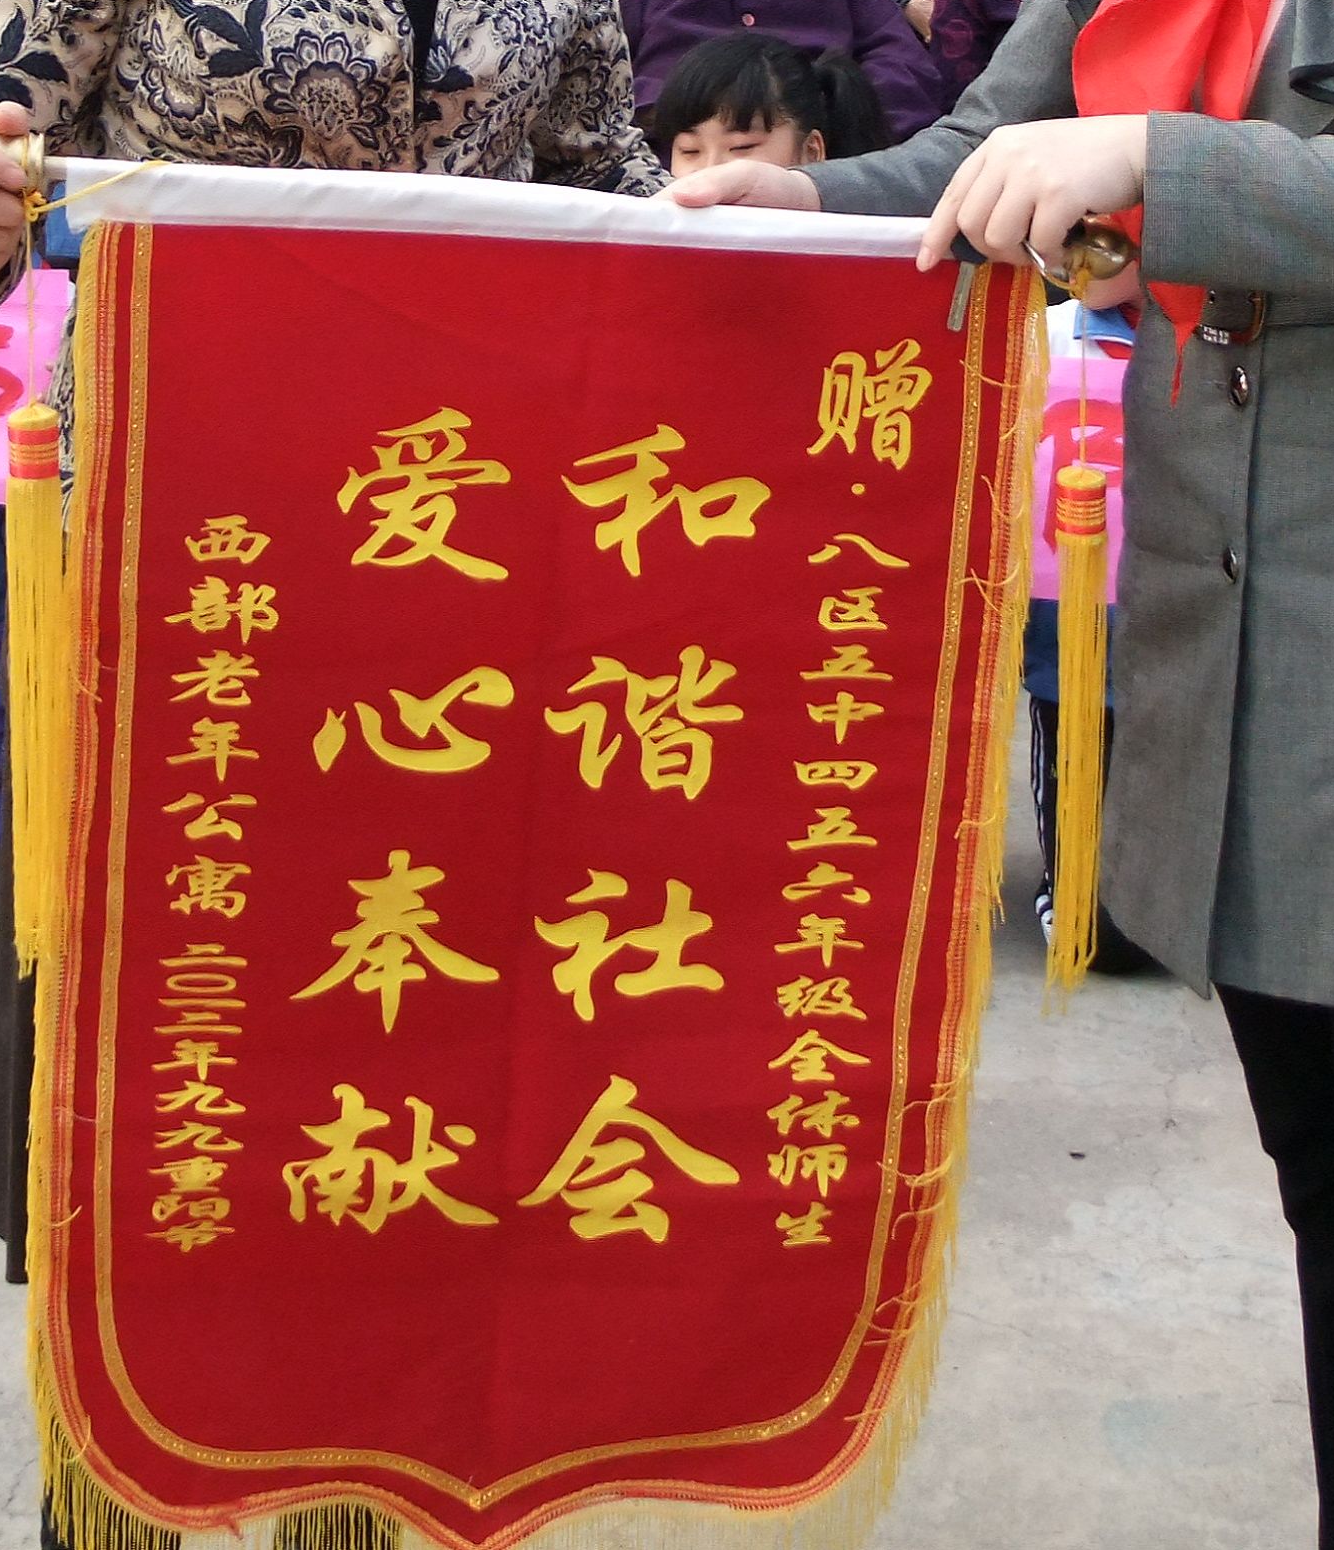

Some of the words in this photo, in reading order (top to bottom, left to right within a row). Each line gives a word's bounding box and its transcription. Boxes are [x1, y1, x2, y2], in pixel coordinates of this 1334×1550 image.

[281, 406, 515, 1235] 爱心奉献
[517, 424, 772, 1244] 和谐社会
